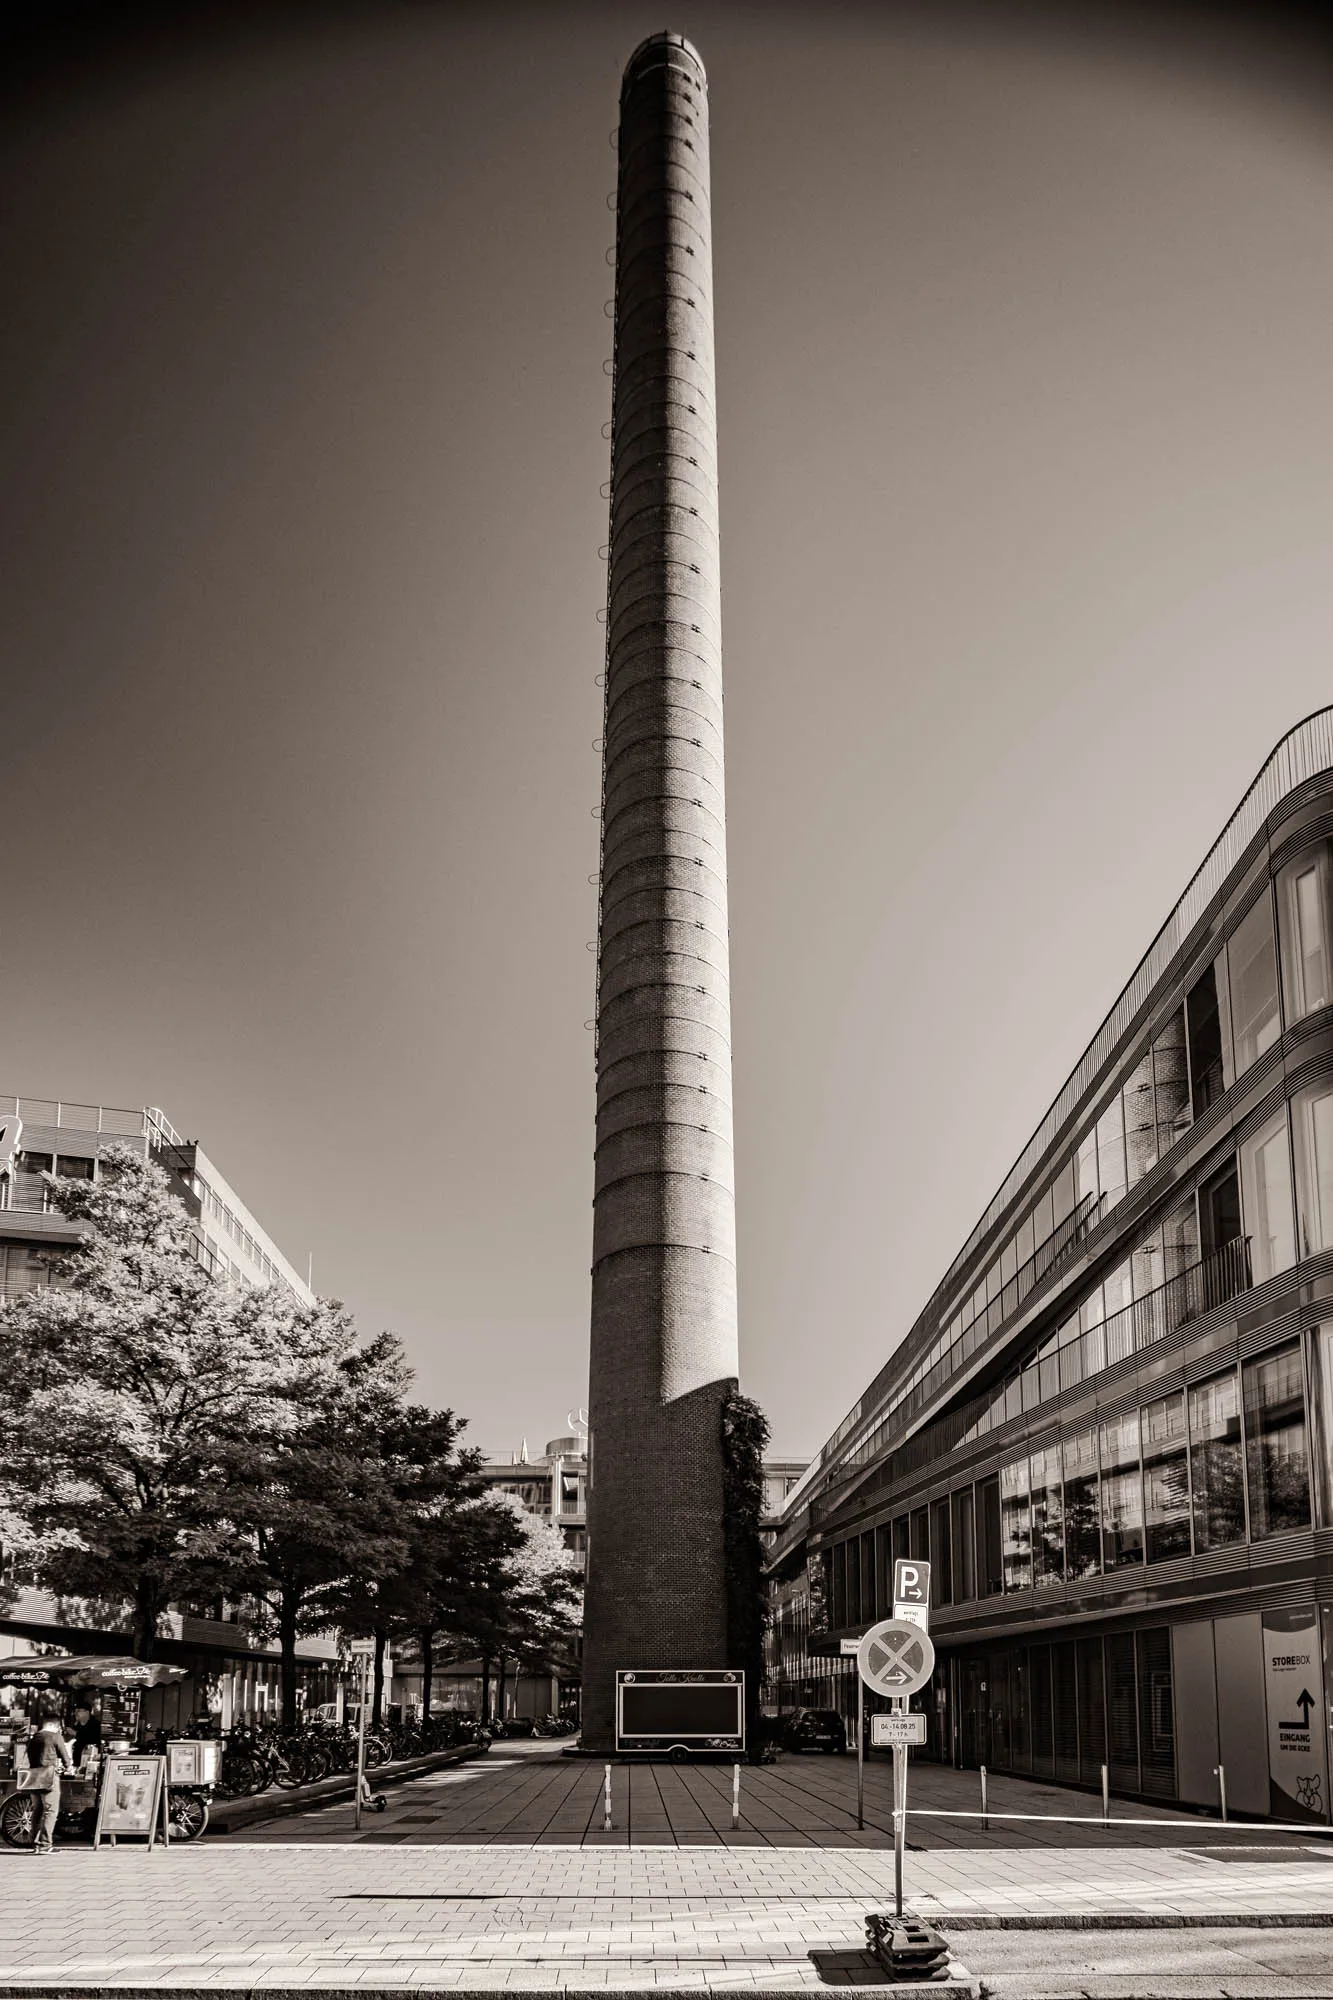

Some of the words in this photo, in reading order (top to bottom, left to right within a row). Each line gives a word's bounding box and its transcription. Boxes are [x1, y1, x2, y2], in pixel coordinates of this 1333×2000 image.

[900, 1566, 919, 1598] P
[1272, 1655, 1311, 1666] STOREBOX
[1280, 1733, 1310, 1742] EINGANG
